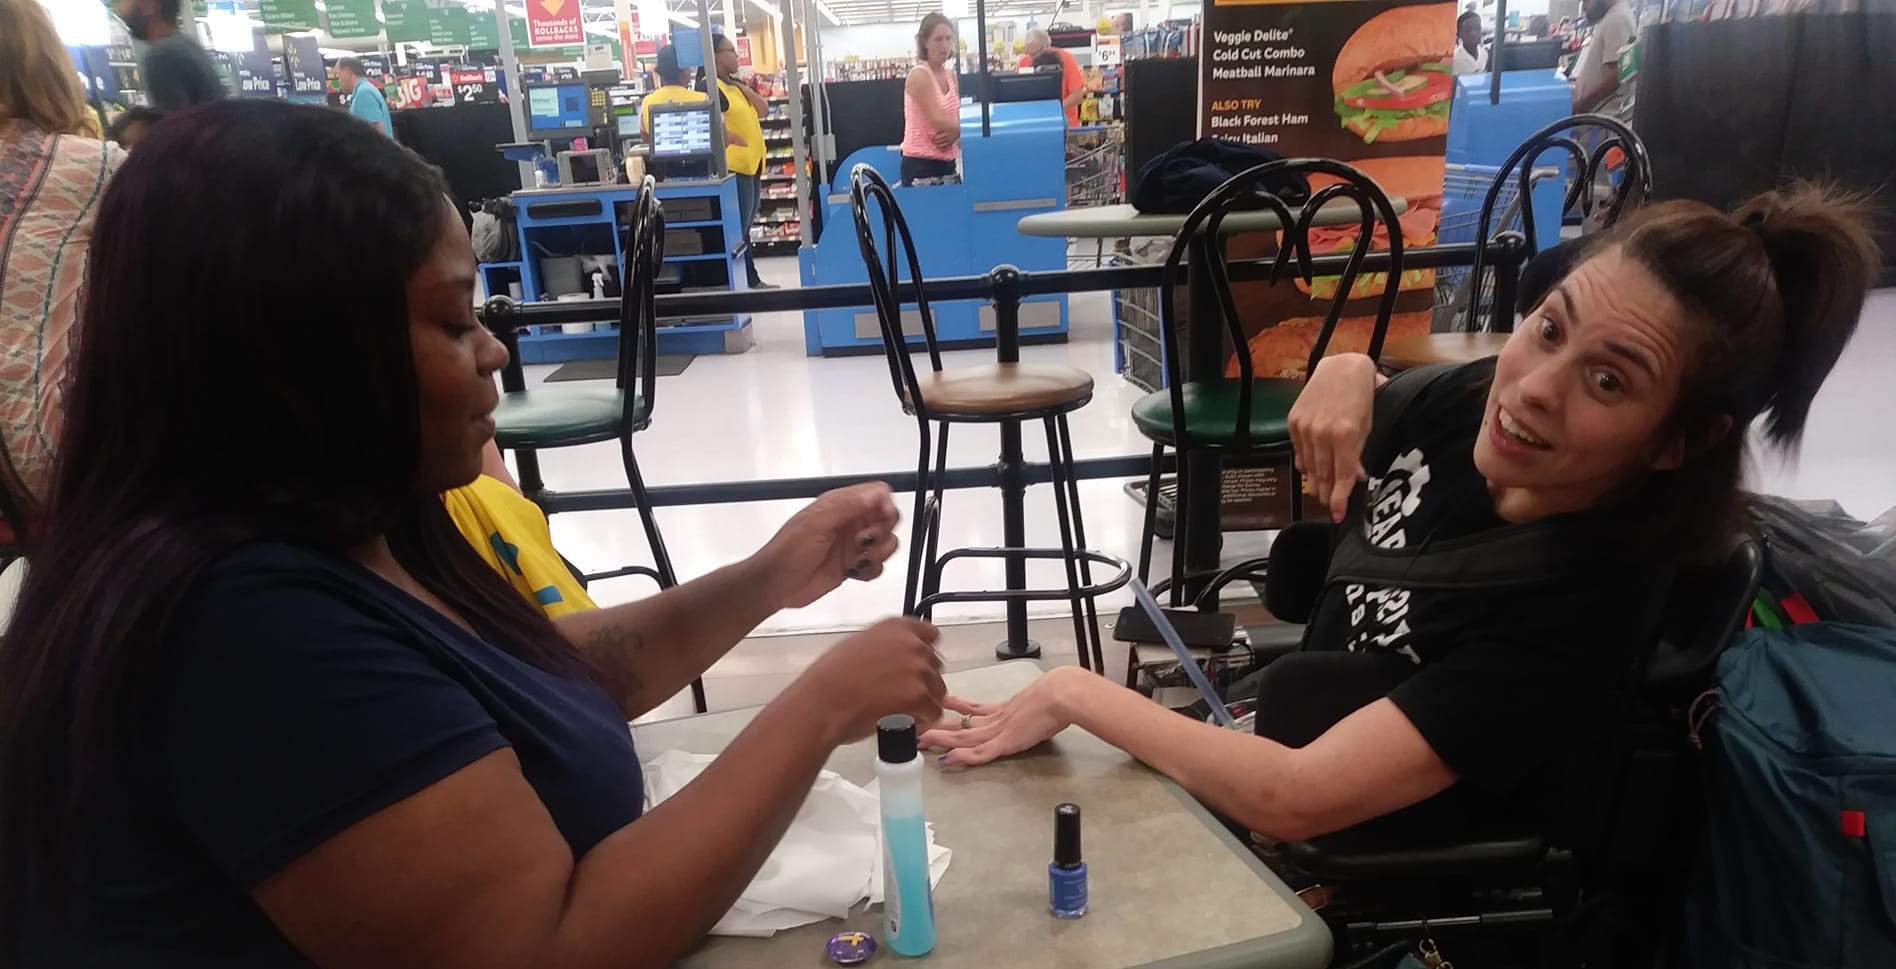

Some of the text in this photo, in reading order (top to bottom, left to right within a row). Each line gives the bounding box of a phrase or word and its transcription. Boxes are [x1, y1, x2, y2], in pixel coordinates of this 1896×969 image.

[533, 17, 576, 27] Thousands of
[535, 25, 579, 34] ROLLBACKS
[1213, 29, 1252, 45] Veggie
[1213, 46, 1306, 61] Cold Cut Combo
[1212, 63, 1316, 80] Meatball Marinara
[253, 76, 270, 91] Price
[294, 78, 306, 92] Low
[306, 76, 321, 91] Price
[1211, 99, 1262, 112] ALSO TRY
[1211, 112, 1309, 128] Black Forest Ham
[1242, 132, 1279, 144] Italian
